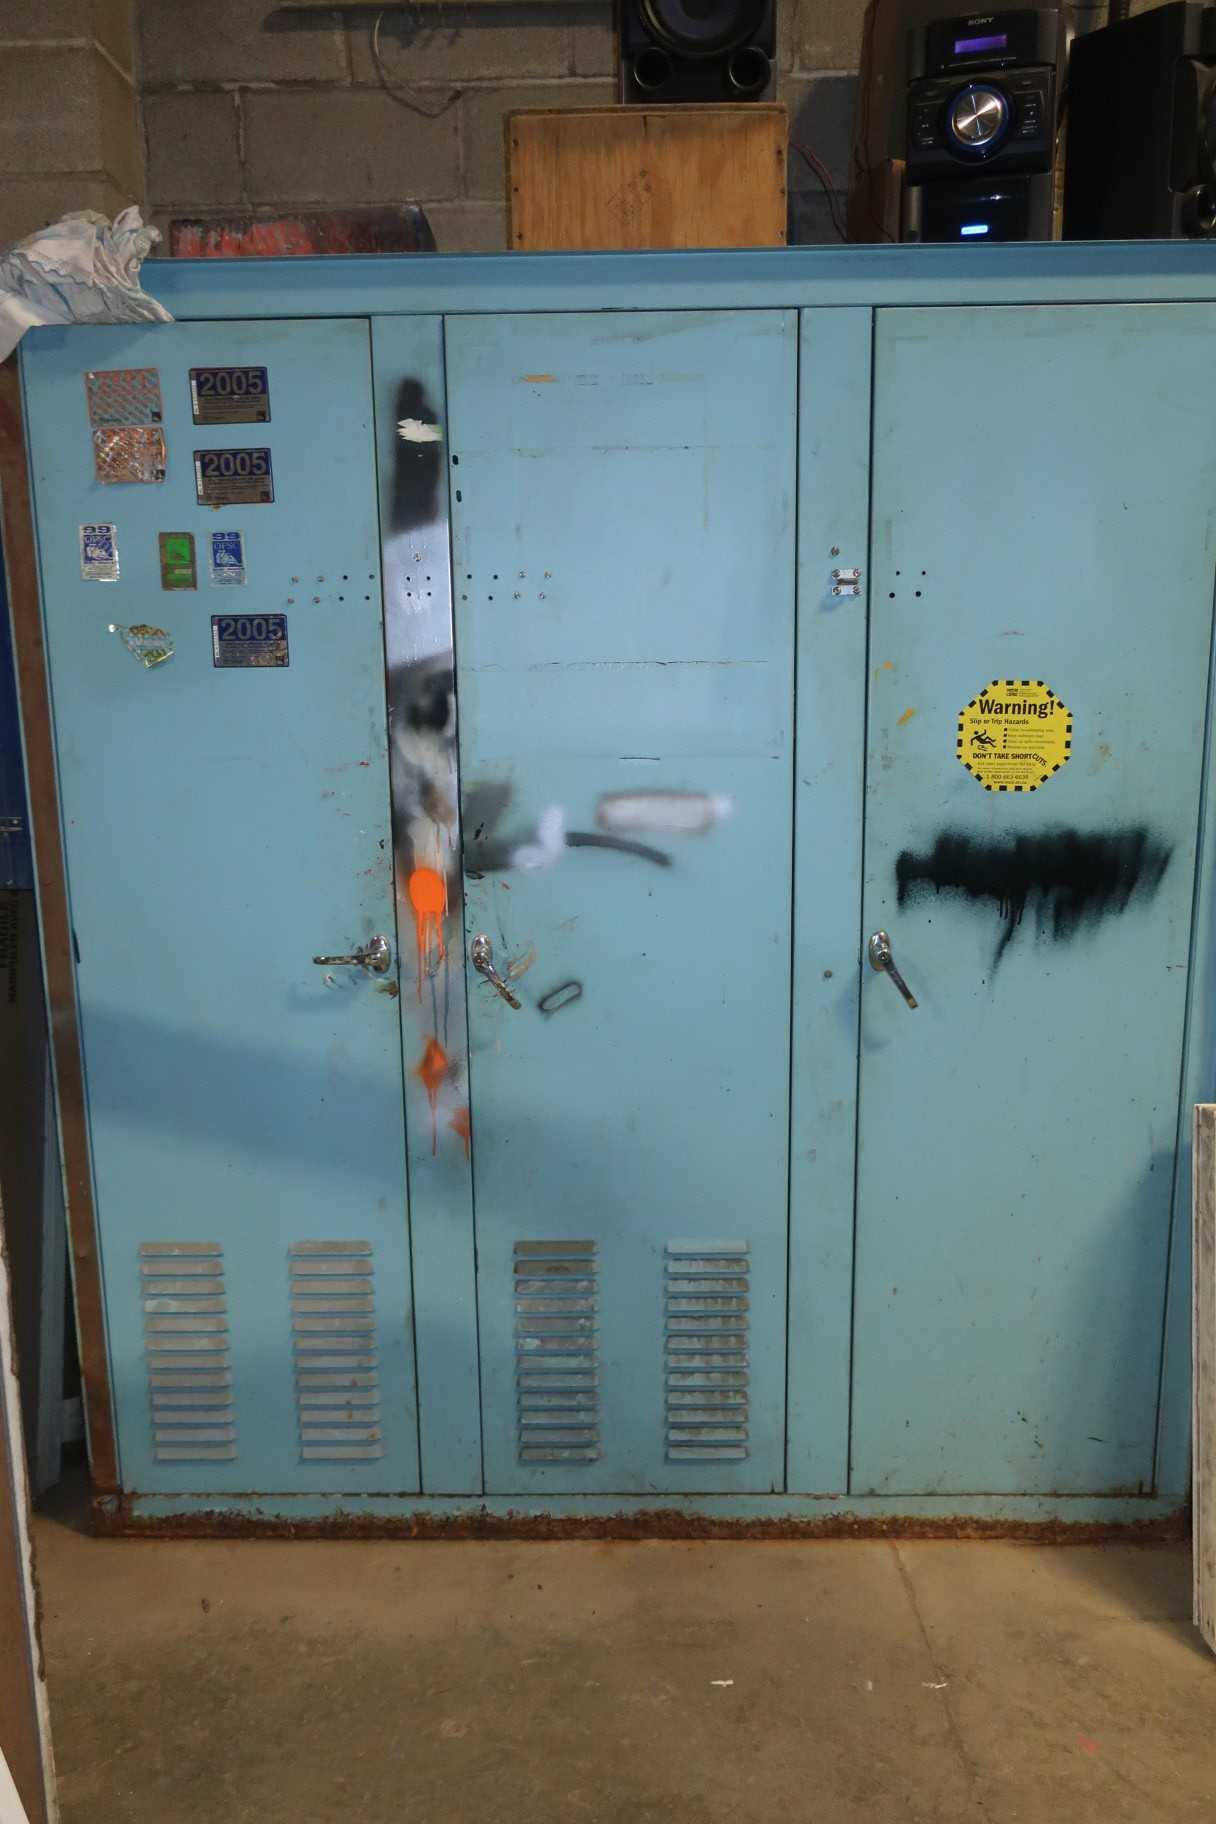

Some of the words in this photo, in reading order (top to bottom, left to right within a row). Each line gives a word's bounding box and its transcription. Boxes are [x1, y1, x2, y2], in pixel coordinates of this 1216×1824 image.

[199, 371, 264, 396] 2005
[204, 452, 267, 477] 2005
[83, 525, 112, 534] 99
[212, 531, 241, 541] 99
[221, 618, 284, 642] 2005
[979, 699, 1055, 719] Warning!
[970, 718, 982, 726] Slip
[991, 718, 1003, 726] Trip
[972, 752, 992, 760] DON'T
[993, 752, 1010, 760] TAKE
